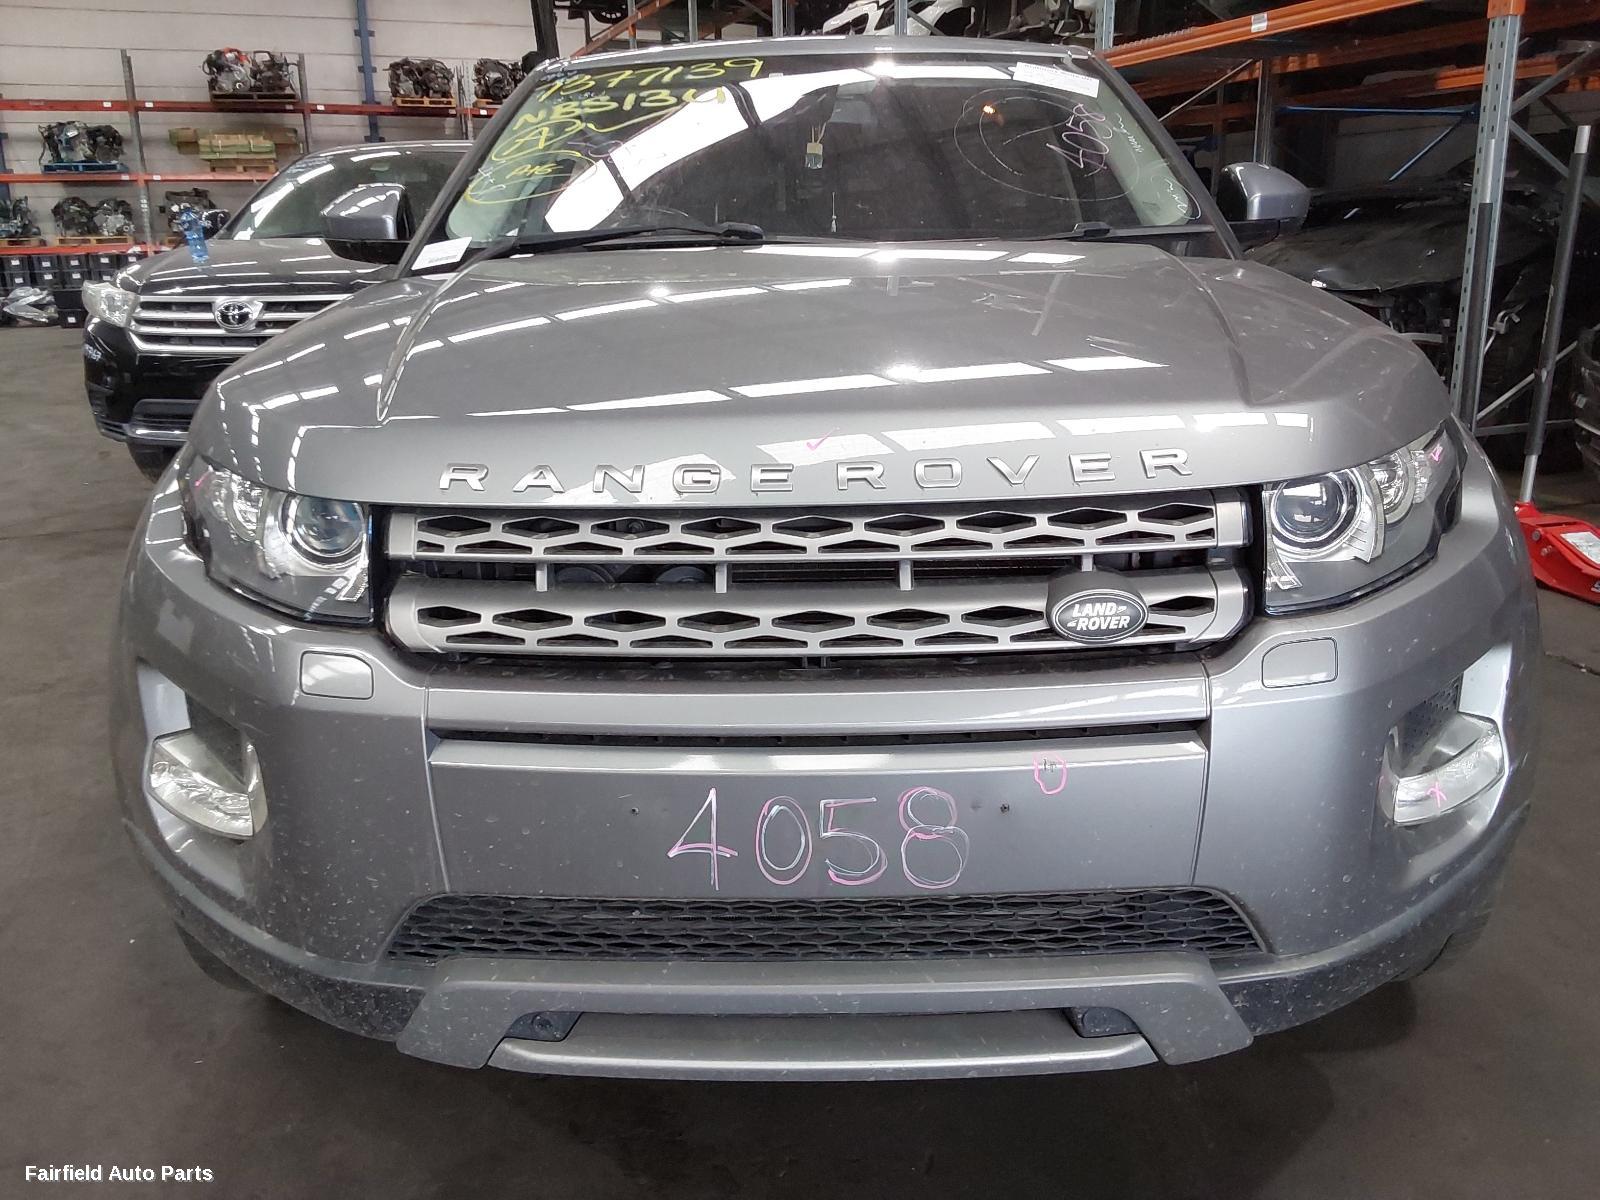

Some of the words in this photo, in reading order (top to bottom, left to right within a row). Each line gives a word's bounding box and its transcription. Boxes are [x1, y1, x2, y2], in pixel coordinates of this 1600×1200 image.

[439, 462, 795, 494] RANGE
[836, 448, 1193, 491] ROVER
[1072, 602, 1117, 618] LAND
[1076, 615, 1131, 631] ROVER
[667, 785, 971, 892] 4058
